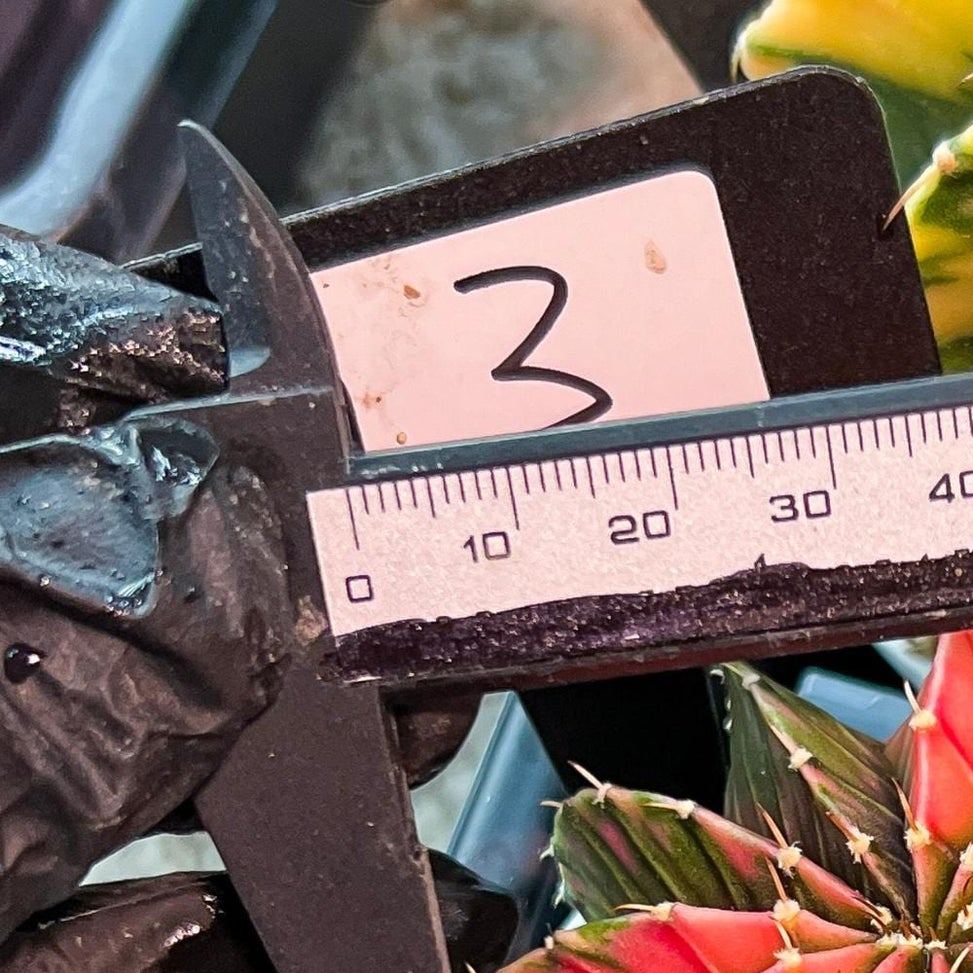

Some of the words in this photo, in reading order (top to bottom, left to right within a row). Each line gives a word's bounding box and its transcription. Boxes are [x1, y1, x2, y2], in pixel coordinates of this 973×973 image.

[345, 575, 374, 603] 0
[462, 531, 512, 563] 10
[607, 510, 671, 545] 20
[768, 489, 831, 523] 30
